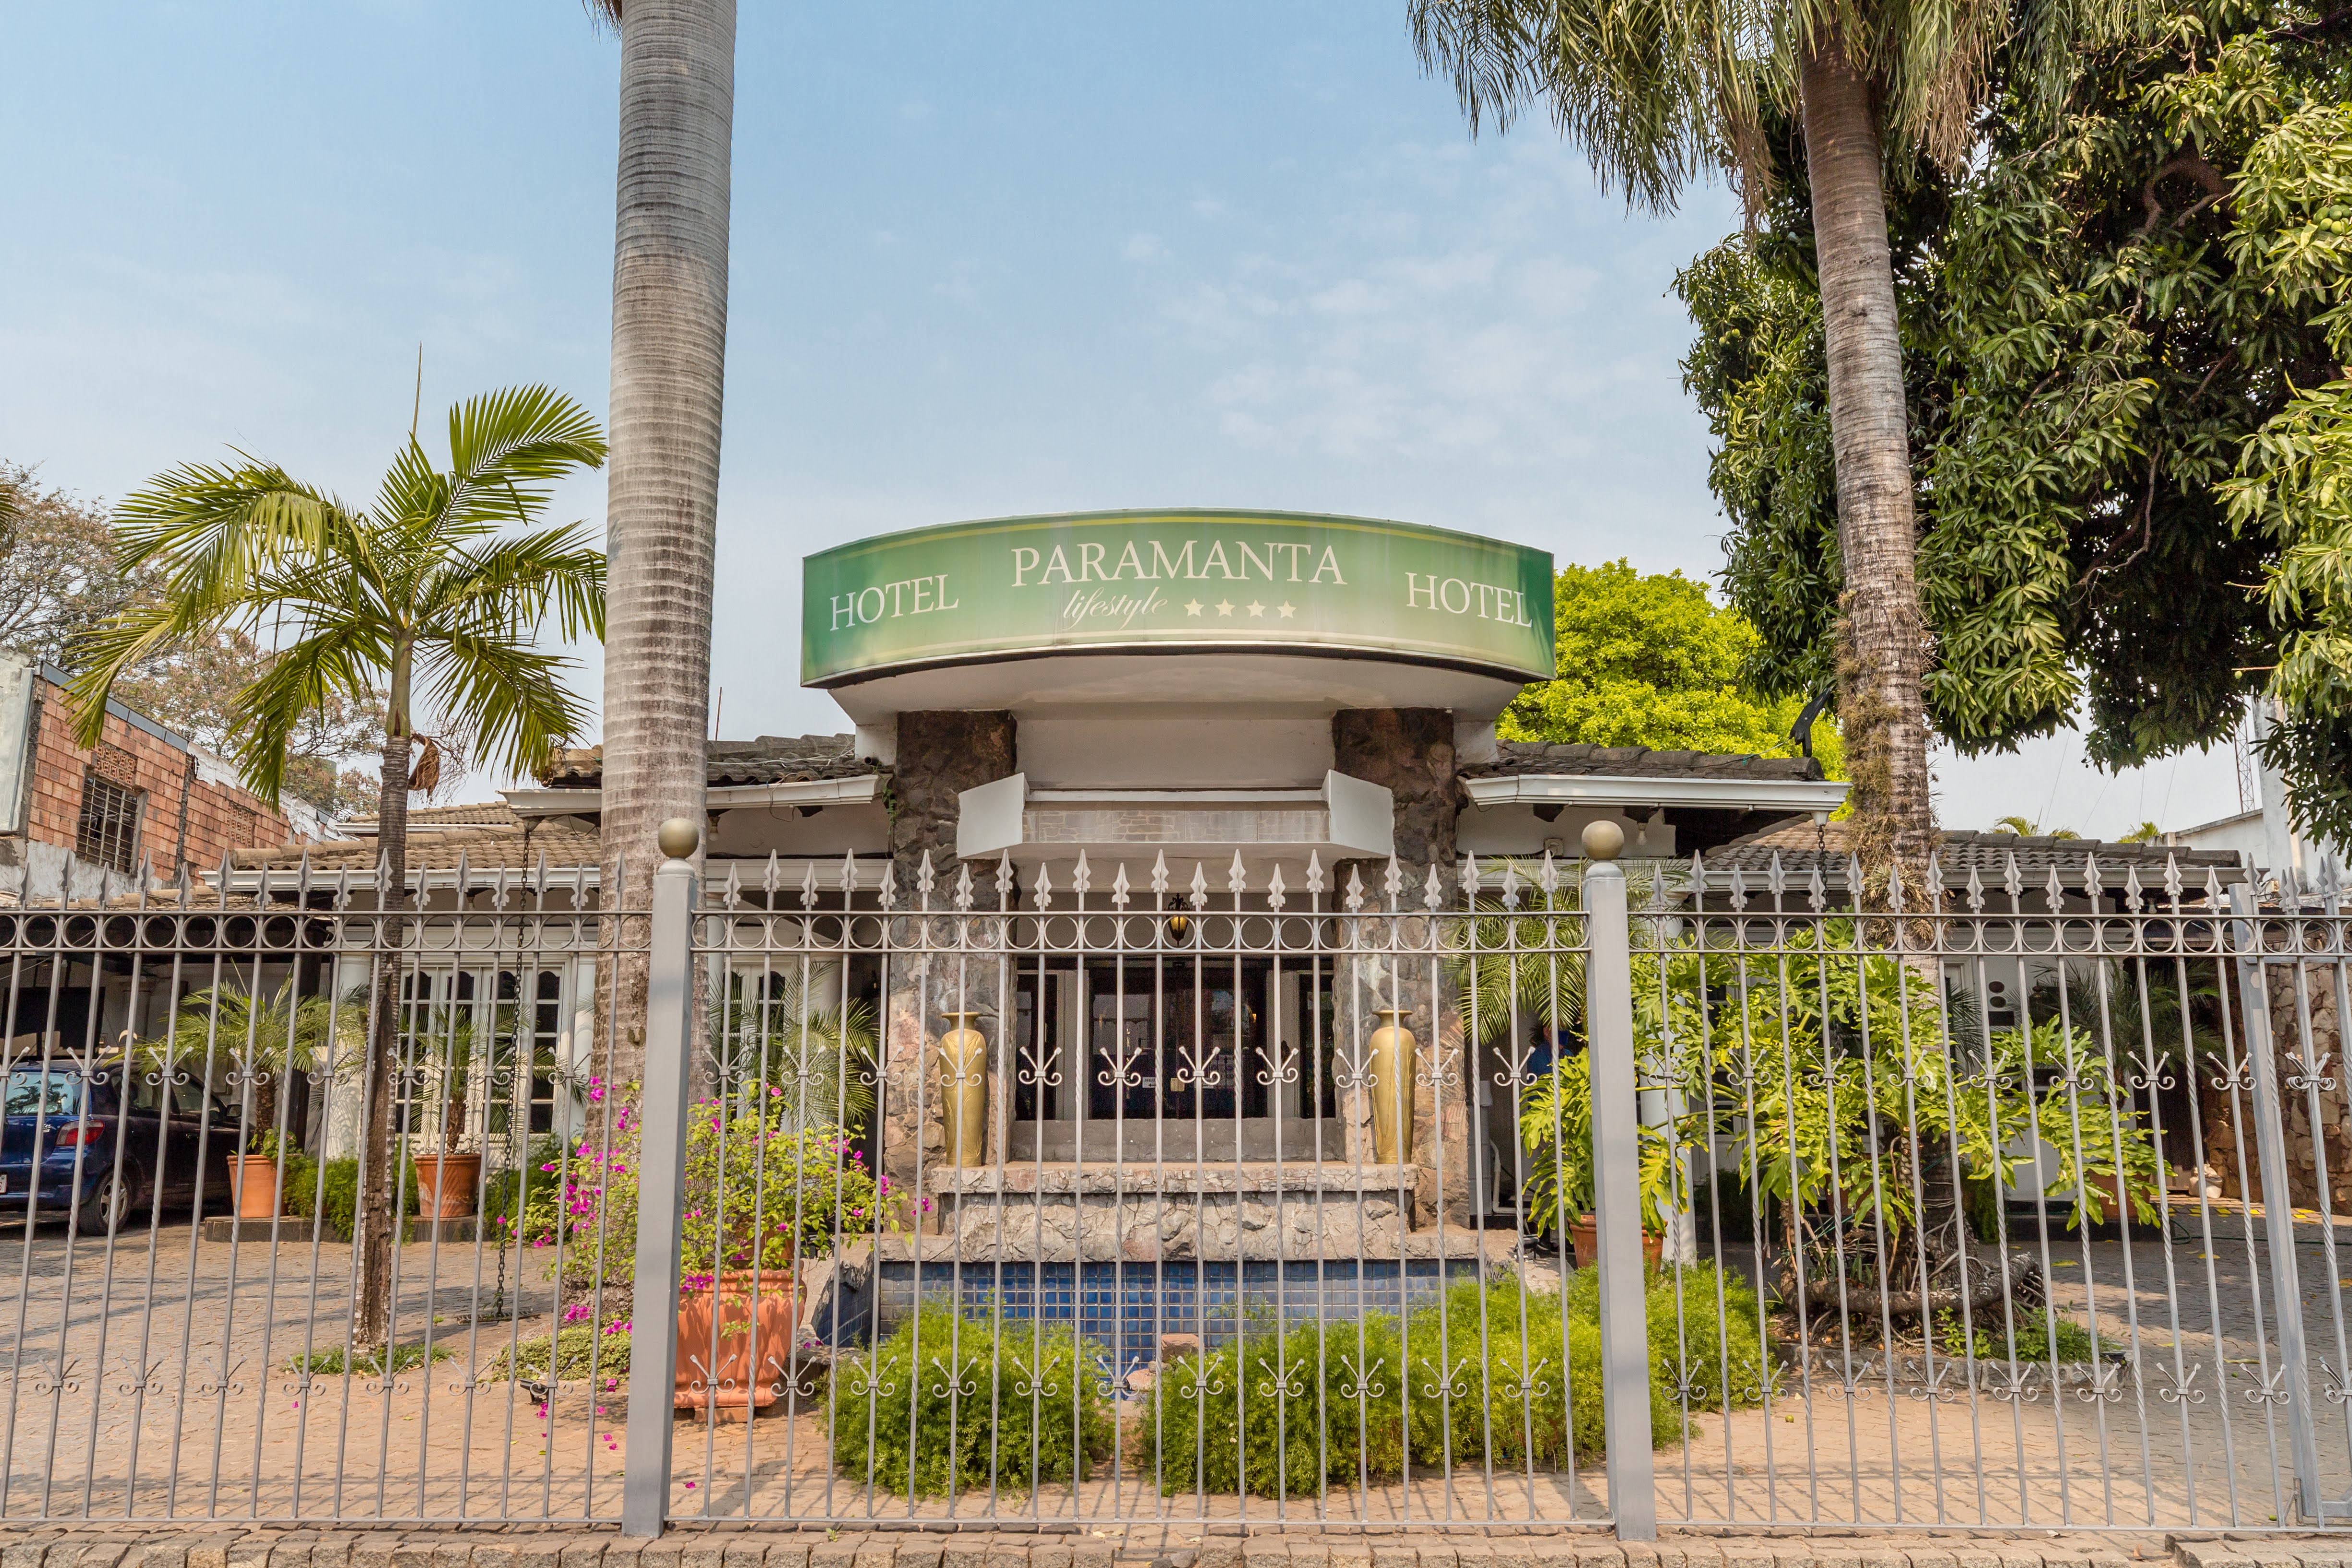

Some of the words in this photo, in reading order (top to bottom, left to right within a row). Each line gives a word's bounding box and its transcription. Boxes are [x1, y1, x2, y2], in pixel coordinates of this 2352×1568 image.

[1010, 539, 1348, 587] PARAMANTA
[829, 574, 959, 631] HOTEL
[1060, 586, 1168, 630] lifestyle
[1405, 571, 1533, 628] HOTEL
